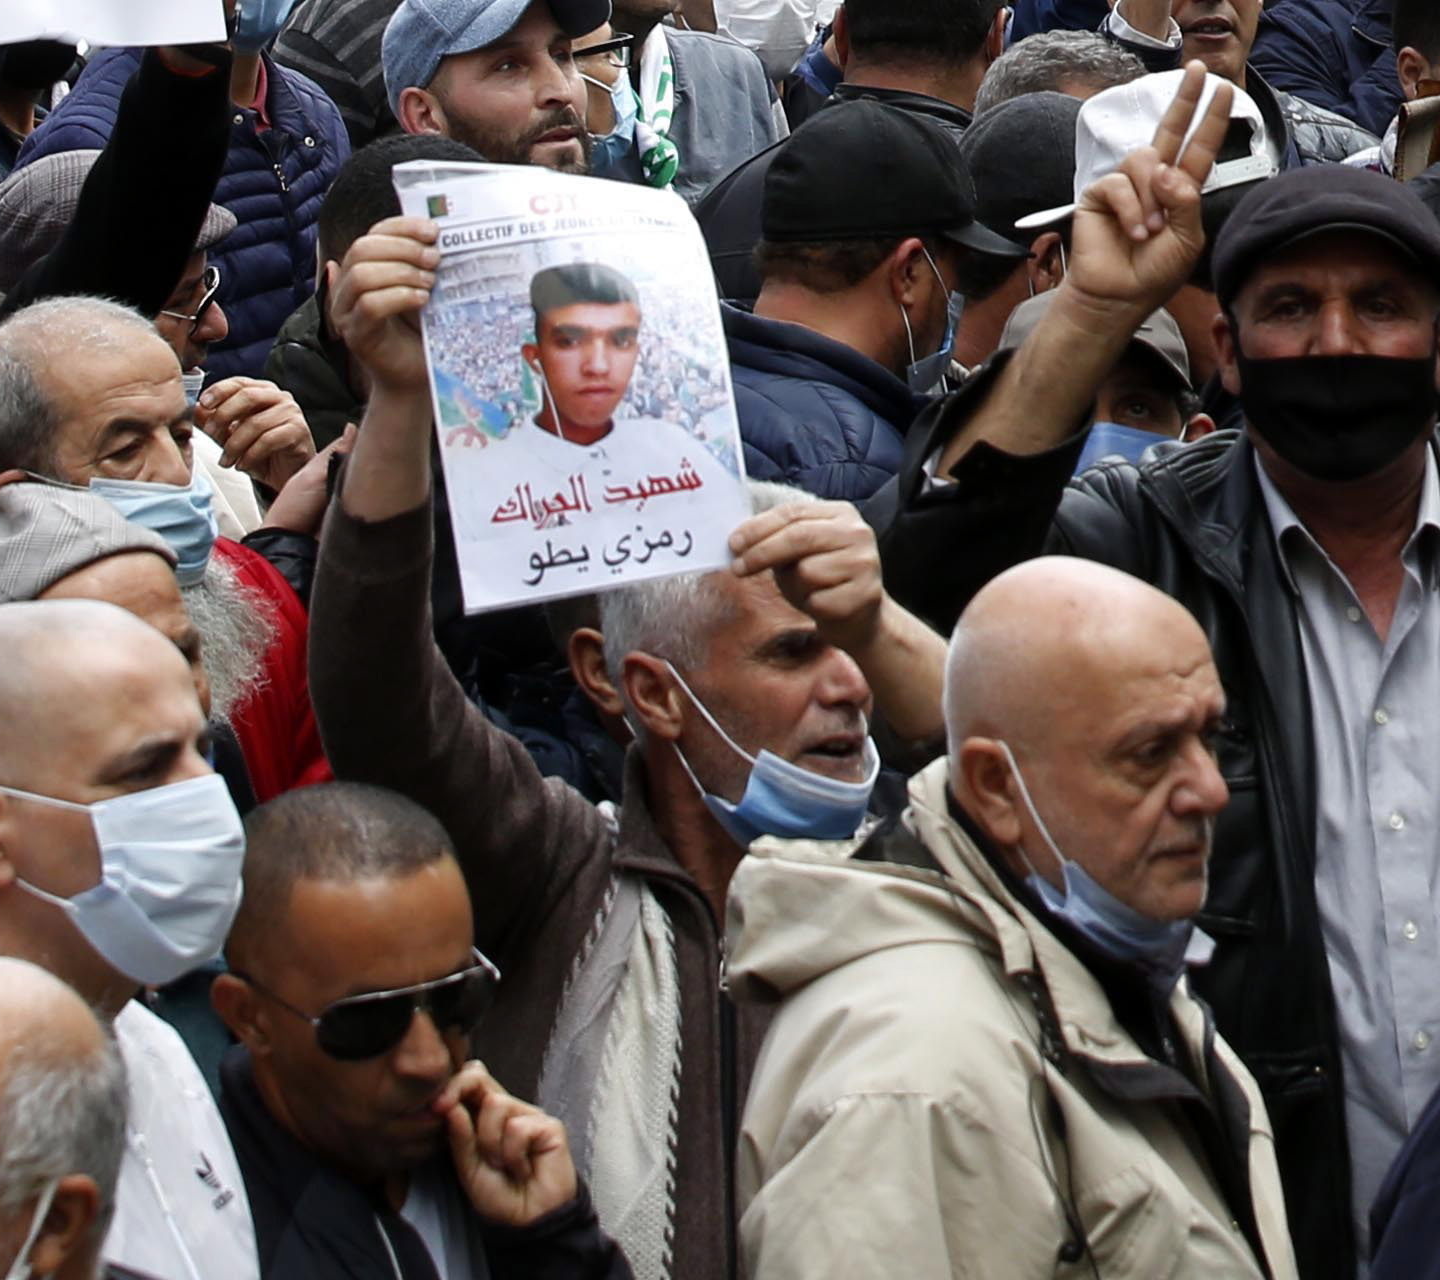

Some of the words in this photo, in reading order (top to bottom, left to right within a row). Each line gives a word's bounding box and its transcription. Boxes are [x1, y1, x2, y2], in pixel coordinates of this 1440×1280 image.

[441, 225, 514, 247] COLLECTIF
[520, 218, 547, 235] DES
[490, 473, 591, 530] الحراك
[602, 456, 704, 513] شهيد
[522, 541, 590, 587] يطو
[601, 523, 694, 575] رمزي
